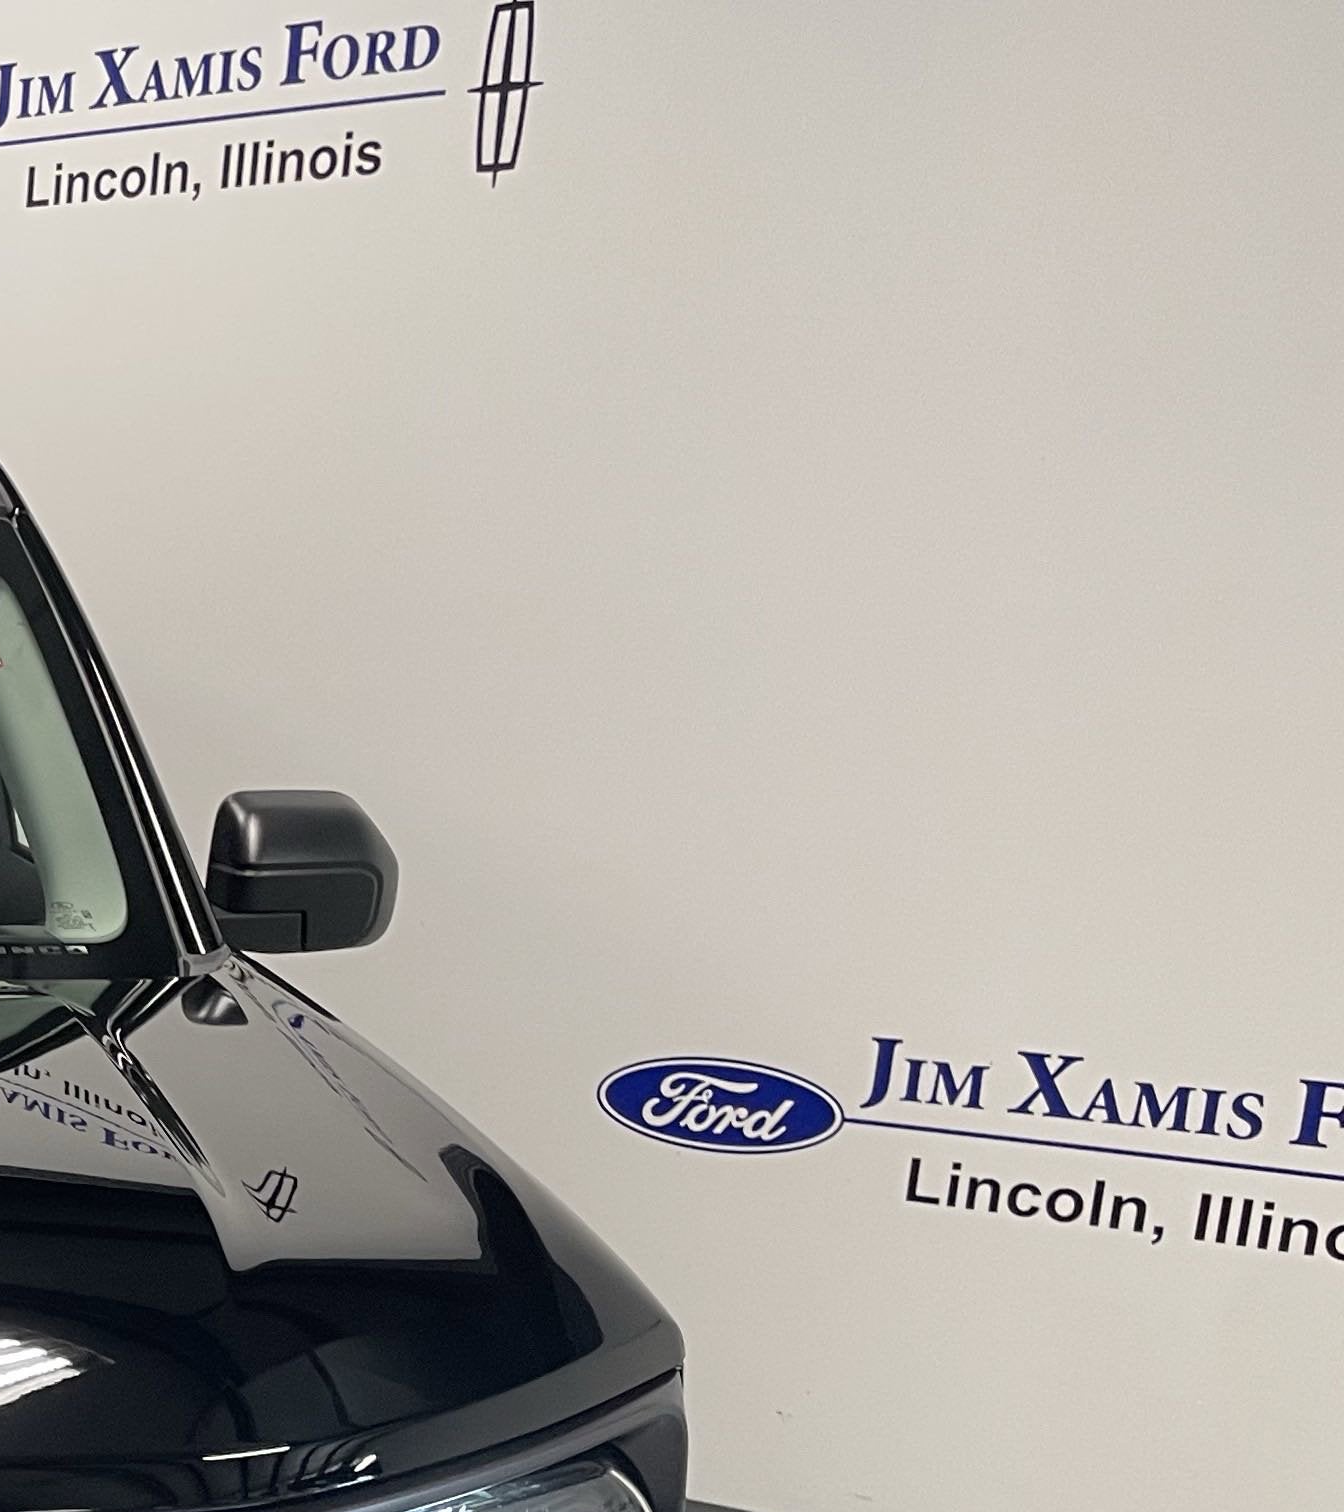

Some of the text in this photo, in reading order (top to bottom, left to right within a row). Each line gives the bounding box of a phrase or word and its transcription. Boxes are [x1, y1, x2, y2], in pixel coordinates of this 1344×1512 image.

[89, 47, 261, 109] XAMIS
[280, 21, 439, 85] FORD
[26, 132, 381, 207] Lincoln, Illinois
[641, 1070, 794, 1142] Ford
[860, 1037, 989, 1109] JIM
[1007, 1052, 1263, 1139] XAMIS
[906, 1158, 1344, 1261] Lincoln, Illin
